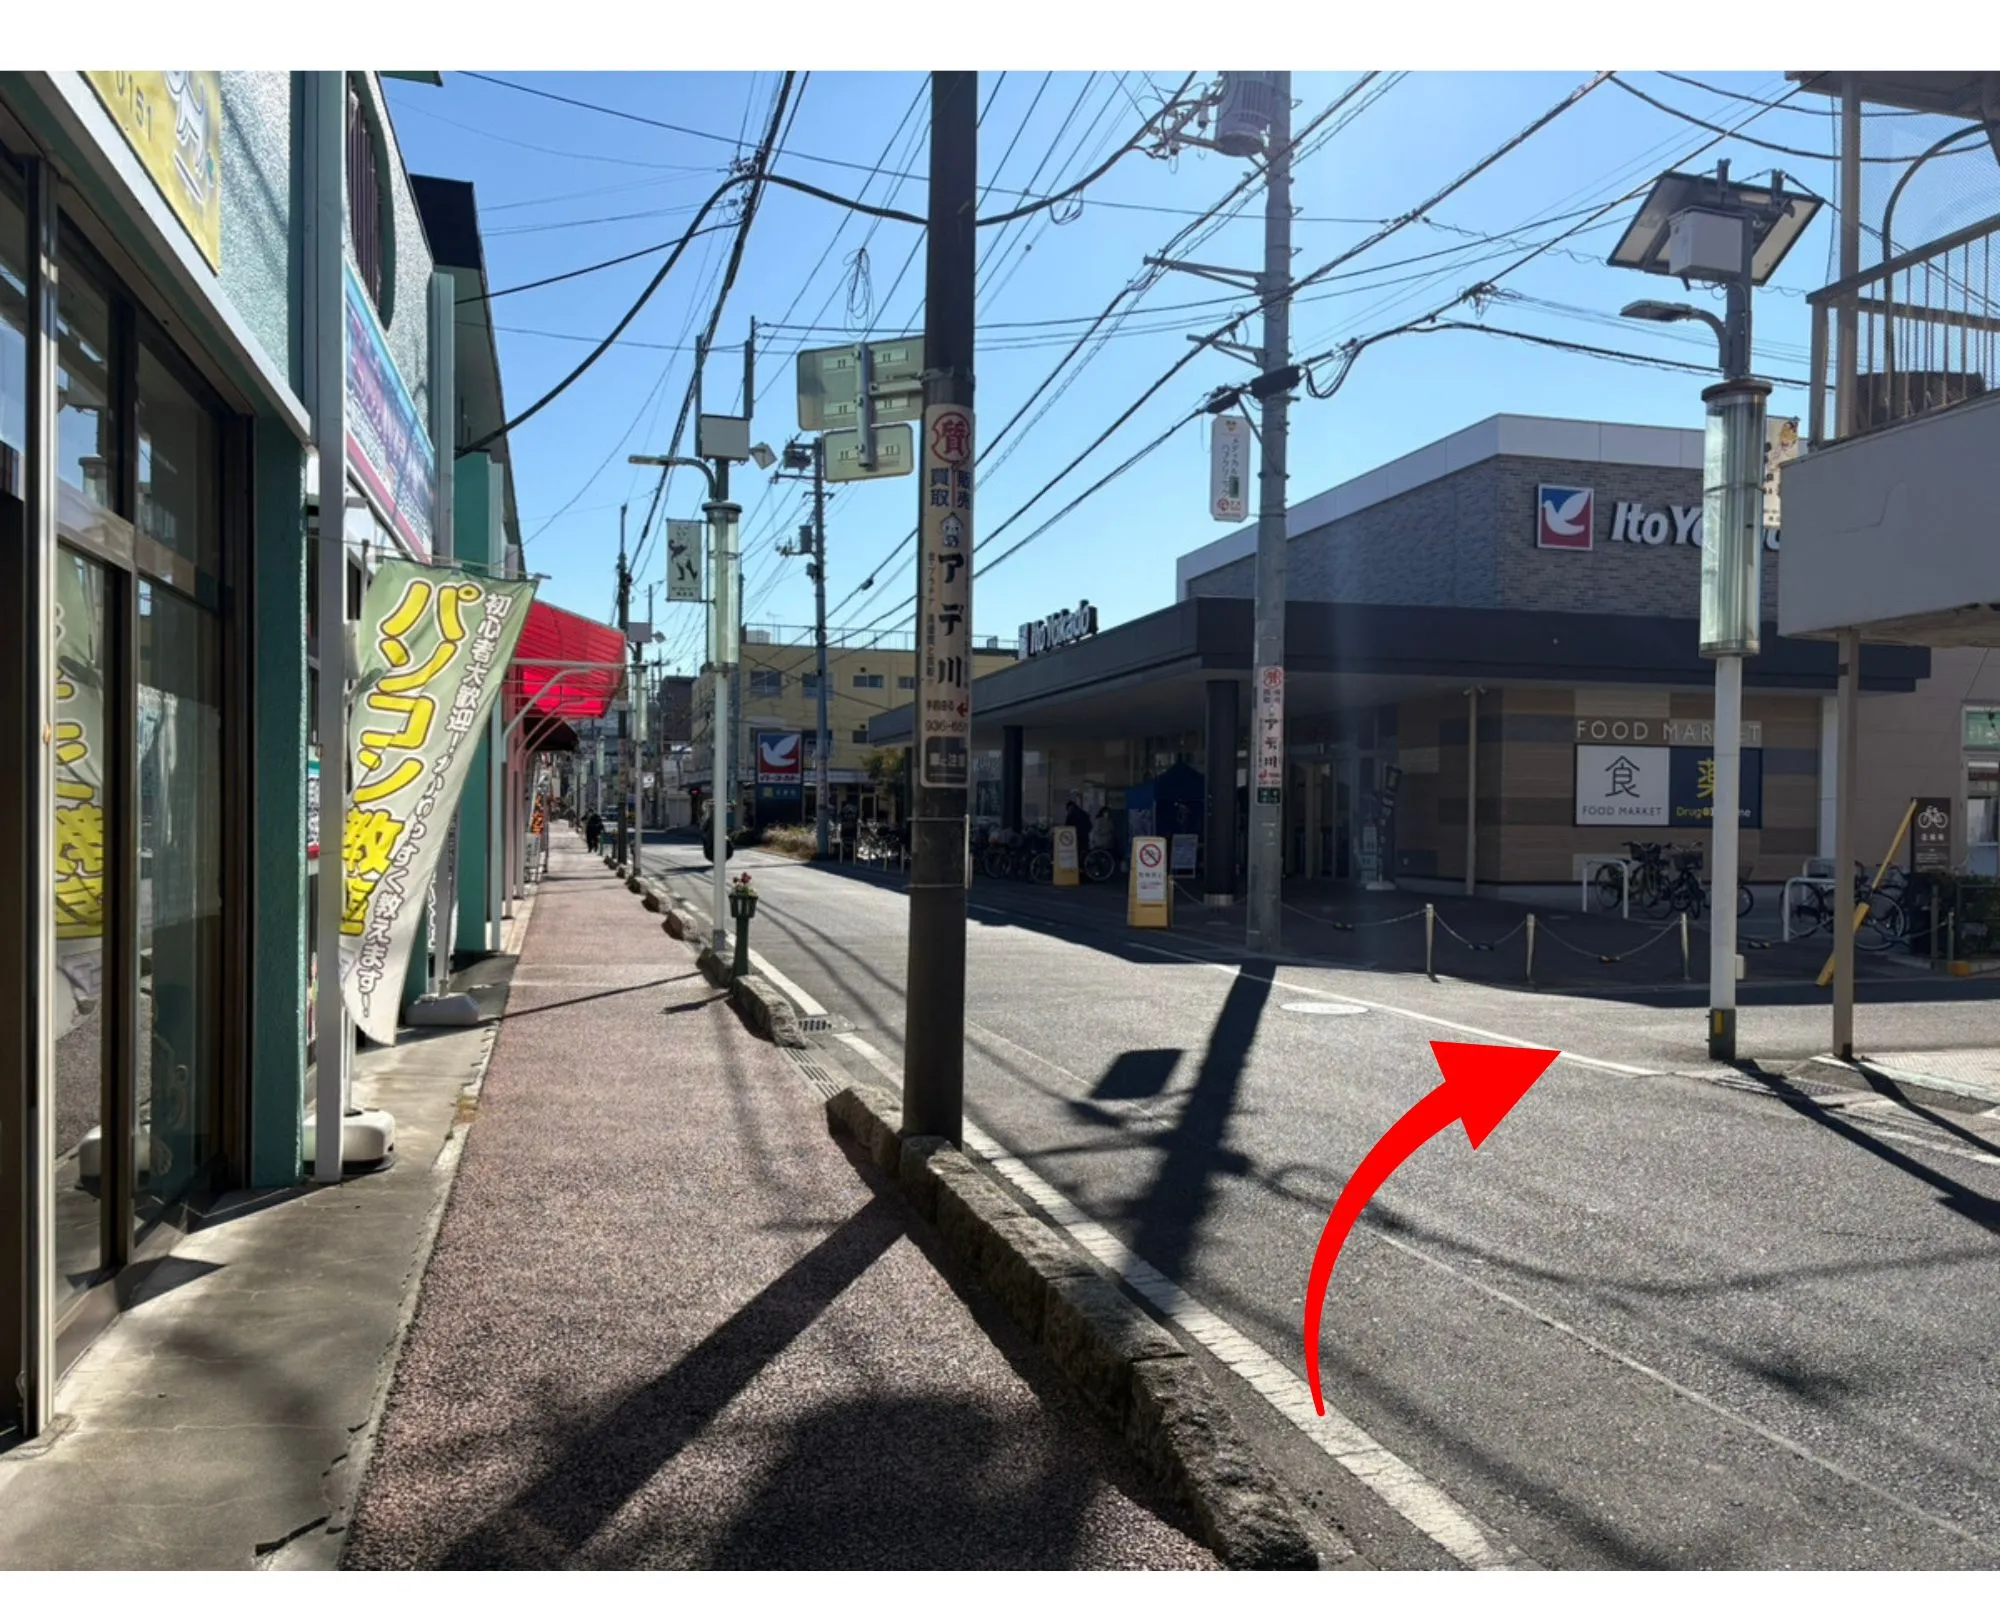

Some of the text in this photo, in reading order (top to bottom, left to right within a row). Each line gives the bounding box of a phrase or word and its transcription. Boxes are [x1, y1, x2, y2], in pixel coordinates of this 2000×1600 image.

[1577, 720, 1649, 741] FOOD
[1605, 755, 1641, 799] 食
[1582, 805, 1663, 817] FOOD MARKET
